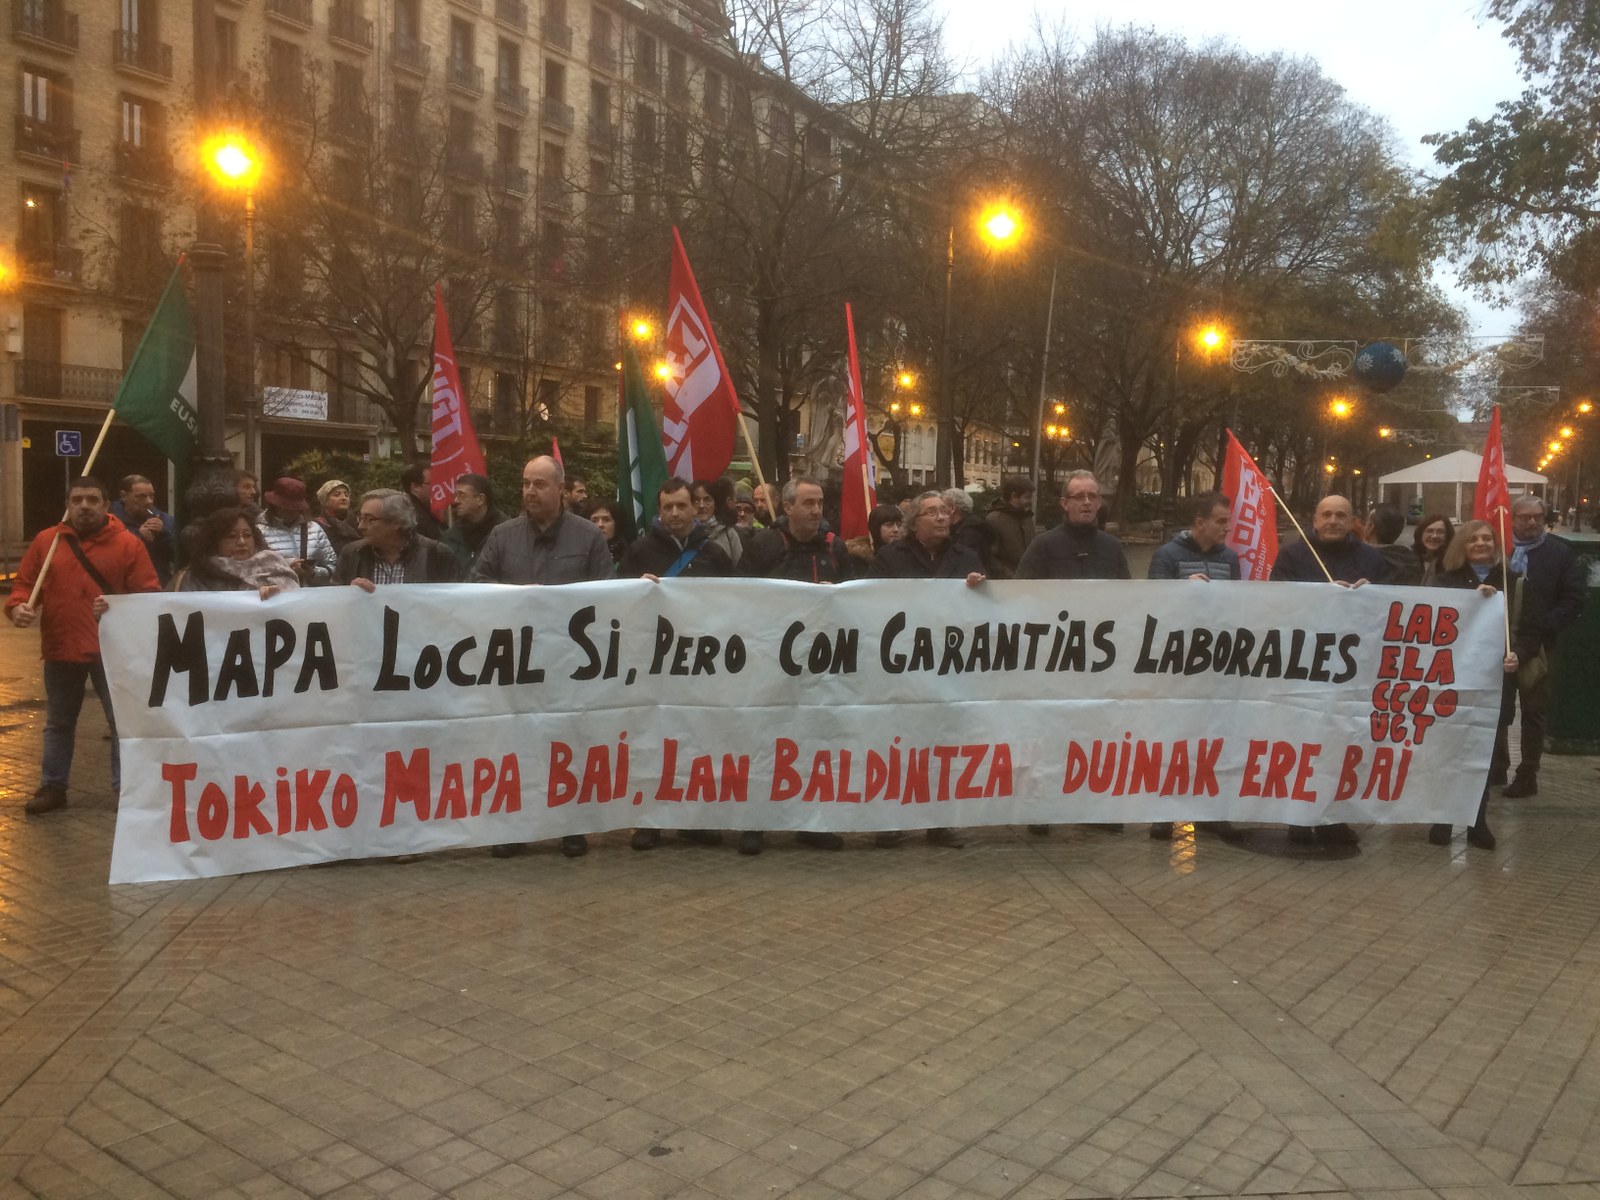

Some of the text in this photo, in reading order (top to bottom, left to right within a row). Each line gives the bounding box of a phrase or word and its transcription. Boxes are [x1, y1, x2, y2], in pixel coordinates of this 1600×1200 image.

[1383, 601, 1459, 646] LAB
[148, 610, 338, 708] MAPA
[374, 604, 545, 692] LOCAL
[649, 615, 747, 676] PERO
[779, 620, 859, 676] CON
[1133, 614, 1361, 684] LABORALES
[1377, 645, 1455, 685] ELA
[1372, 680, 1458, 717] CCOO
[1370, 710, 1435, 745] UGT
[380, 747, 522, 828] MAPA
[655, 738, 750, 804] LAN
[1239, 740, 1322, 803] ERE
